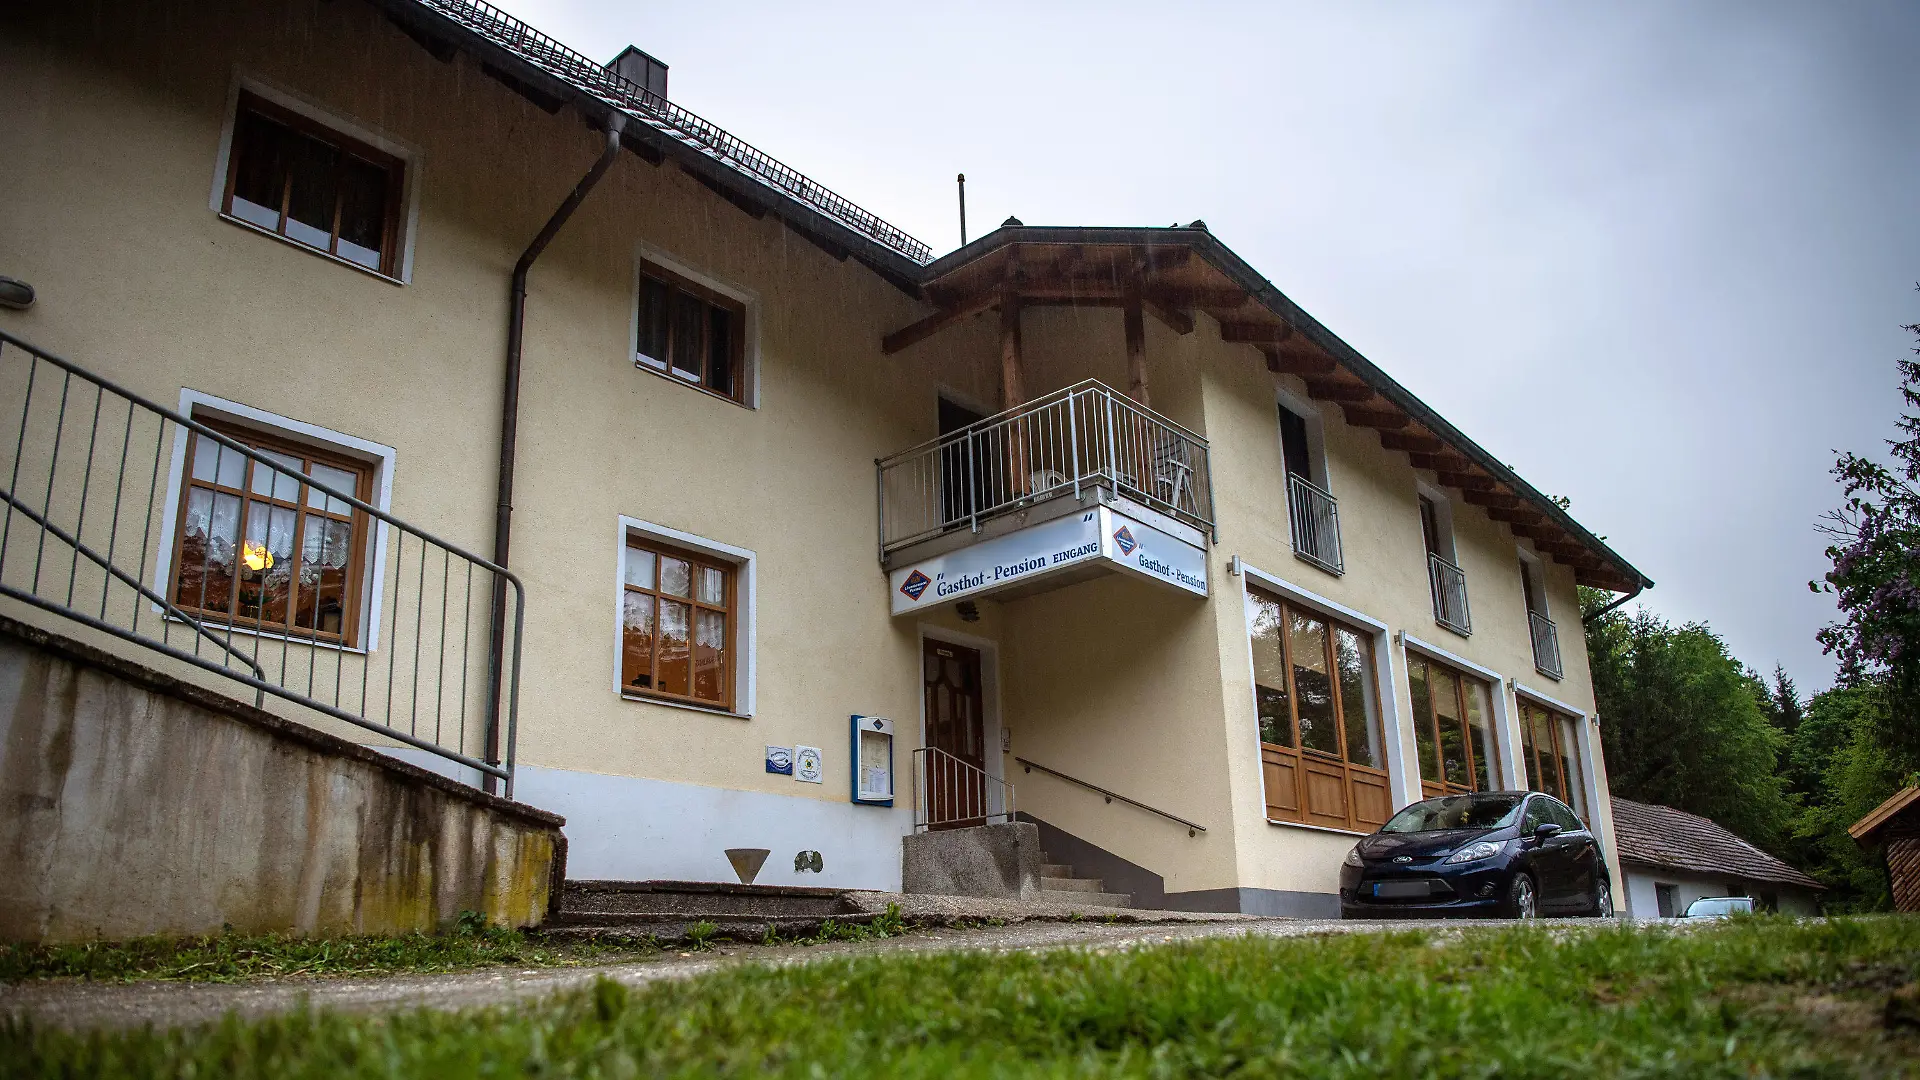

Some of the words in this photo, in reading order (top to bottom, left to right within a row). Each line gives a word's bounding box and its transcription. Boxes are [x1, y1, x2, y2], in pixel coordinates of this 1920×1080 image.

[994, 558, 1046, 581] Pension
[1052, 542, 1098, 564] EINGANG
[1138, 553, 1170, 577] Gasthof
[1176, 568, 1206, 591] Pension
